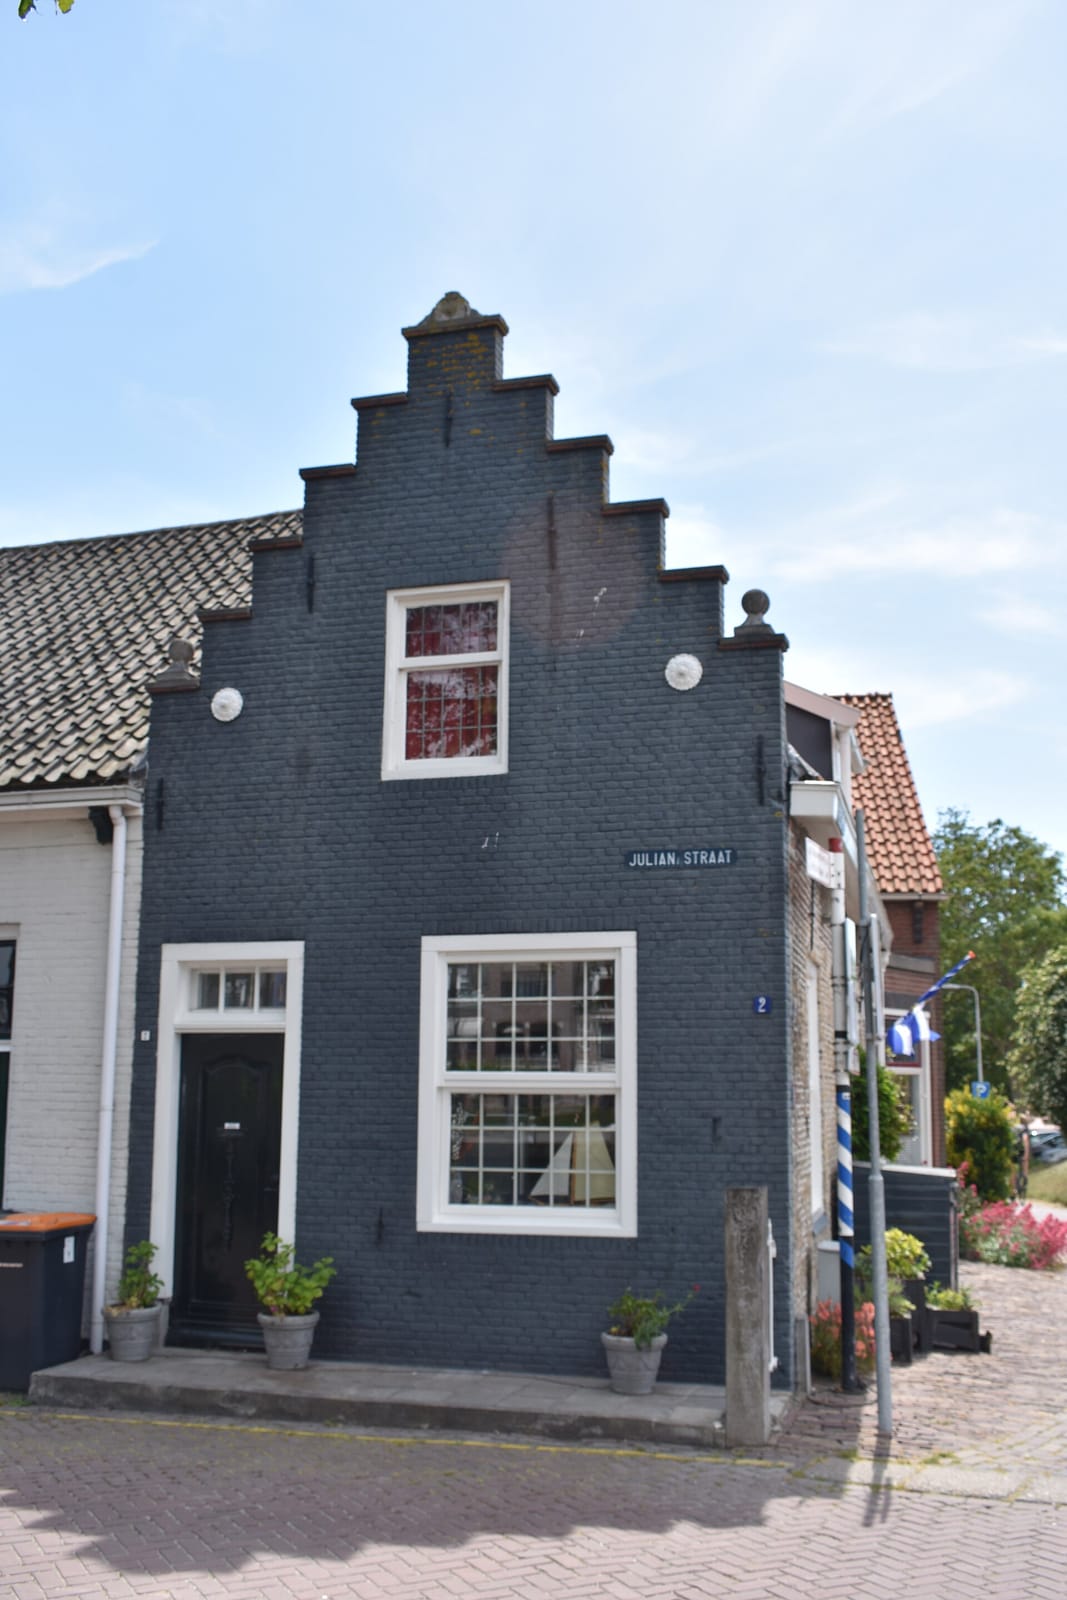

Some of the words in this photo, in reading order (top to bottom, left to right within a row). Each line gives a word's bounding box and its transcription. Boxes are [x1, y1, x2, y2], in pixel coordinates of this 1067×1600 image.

[684, 850, 732, 865] STRAAT
[758, 997, 766, 1013] 2
[976, 1084, 987, 1097] P
